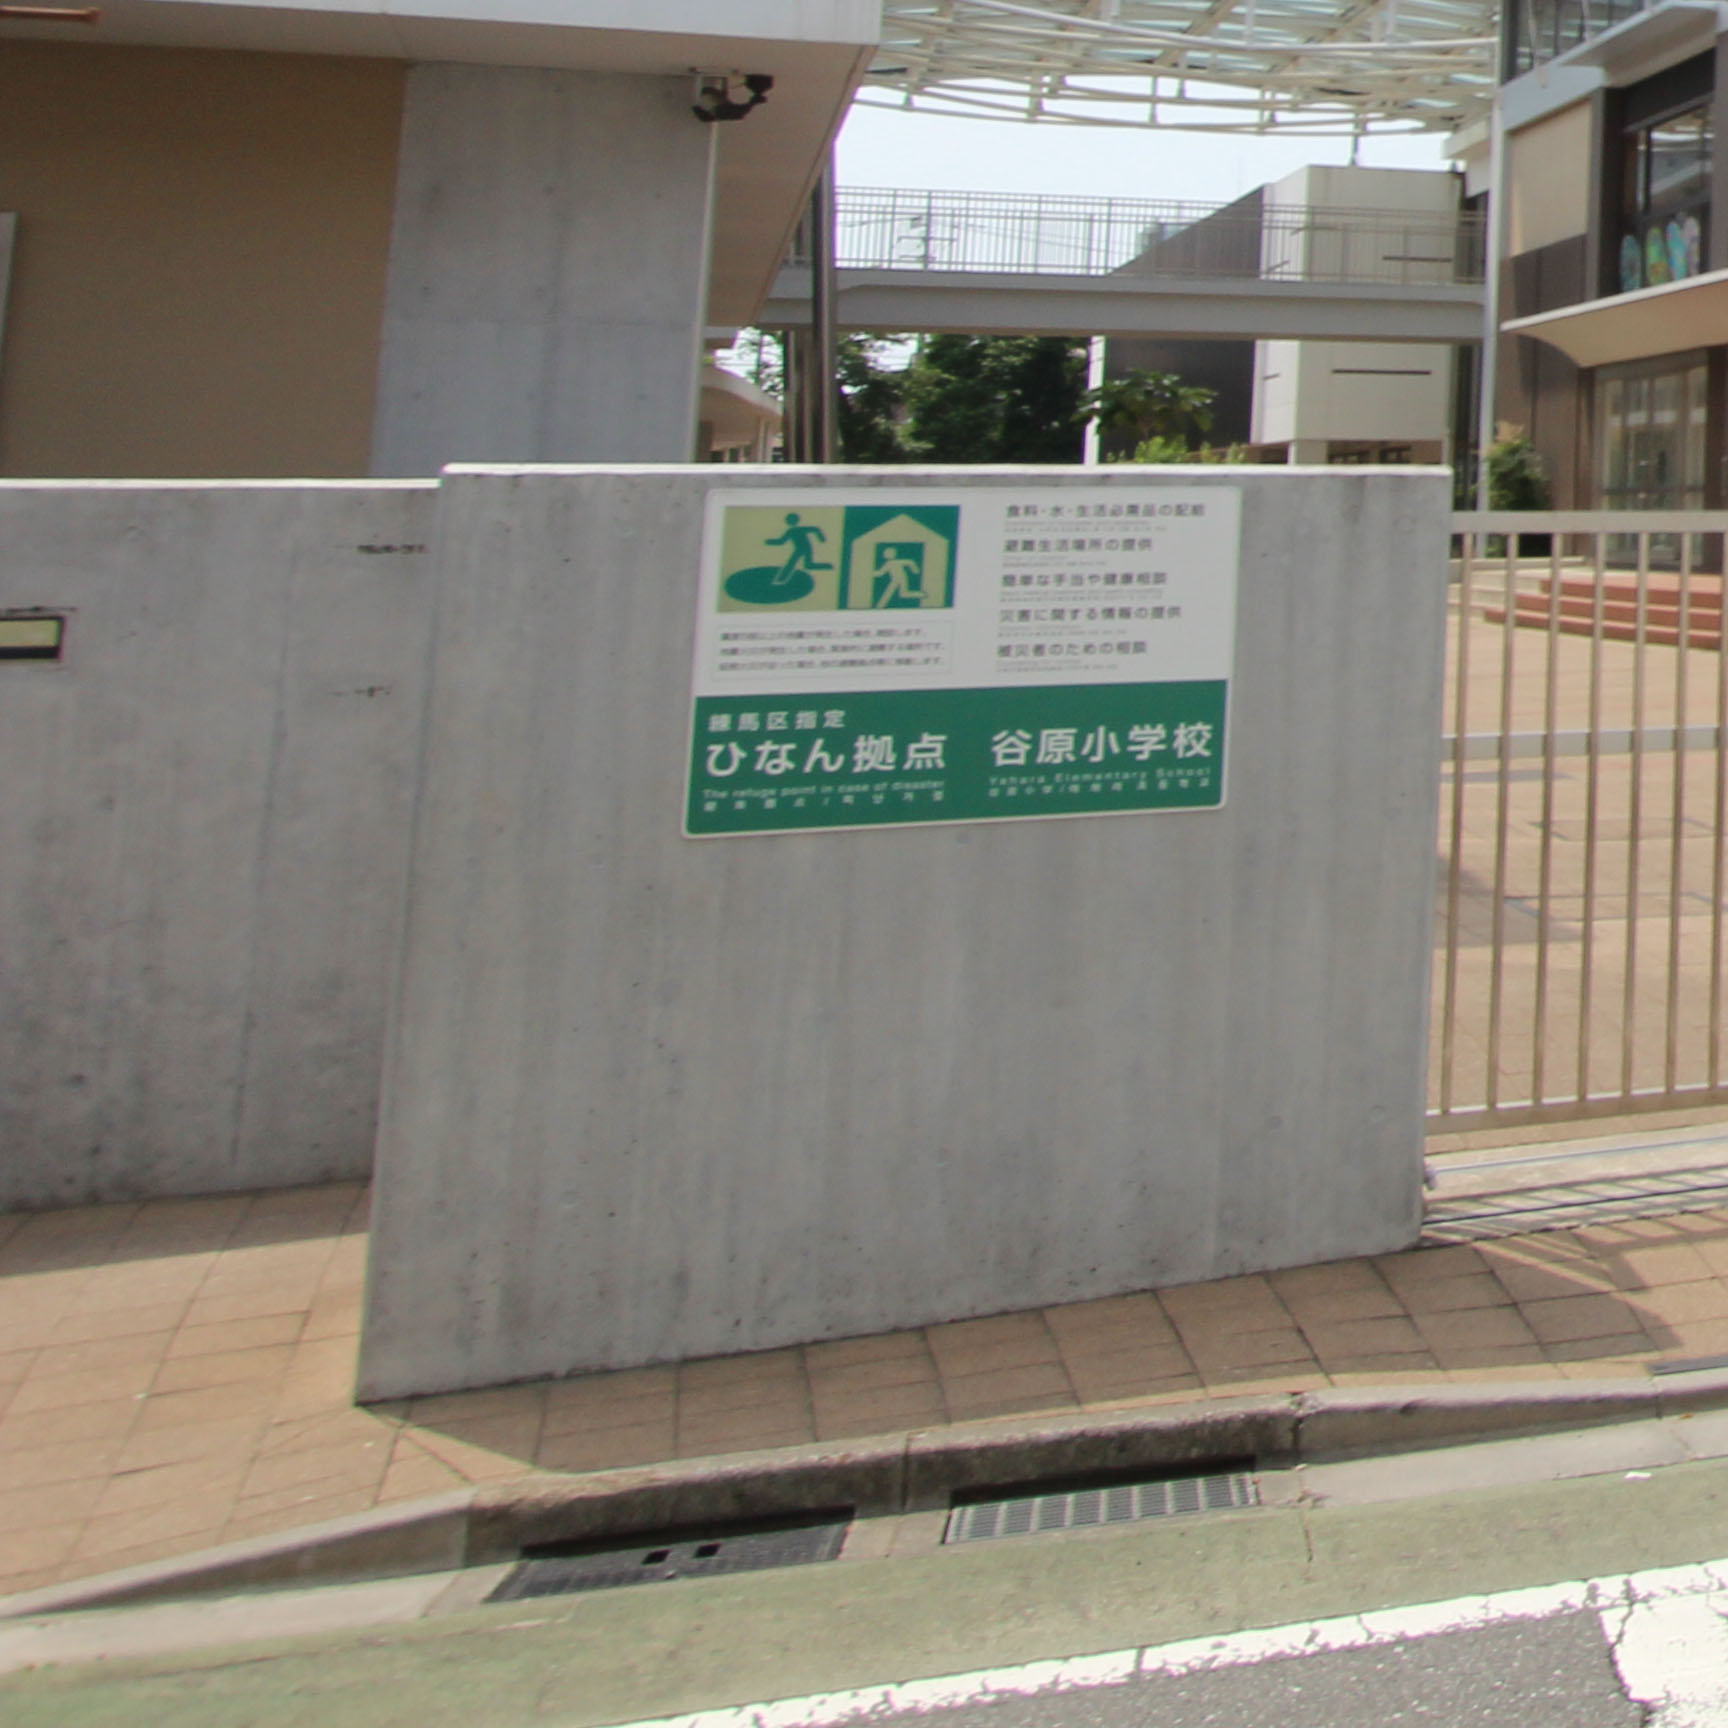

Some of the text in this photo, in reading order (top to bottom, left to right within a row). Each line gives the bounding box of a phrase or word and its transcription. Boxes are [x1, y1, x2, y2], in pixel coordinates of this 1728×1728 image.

[708, 709, 847, 733] 練馬区指定
[705, 720, 1214, 778] ひなん拠点 谷原小学校
[702, 788, 729, 799] The
